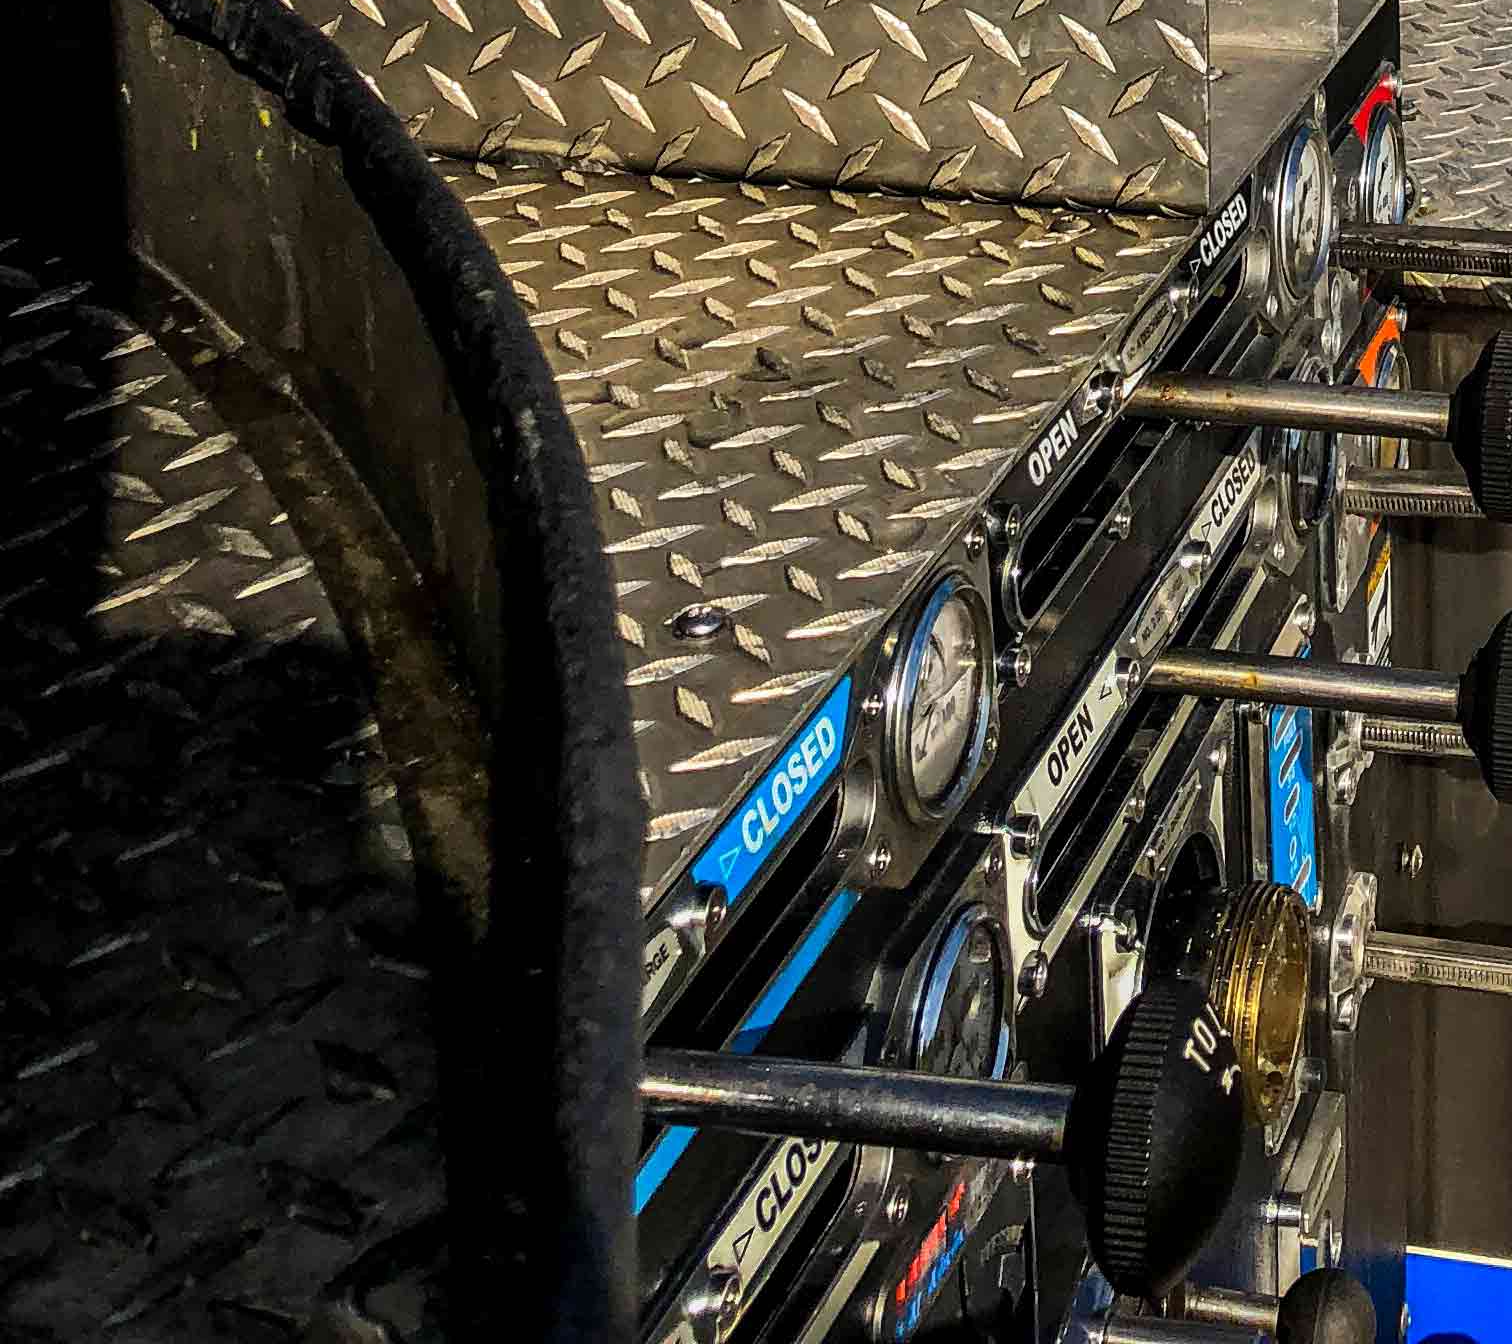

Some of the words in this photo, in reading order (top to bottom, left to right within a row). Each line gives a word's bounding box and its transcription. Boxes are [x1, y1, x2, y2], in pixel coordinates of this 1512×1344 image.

[1200, 193, 1248, 267] CLOSED
[1028, 409, 1079, 487] OPEN
[1211, 446, 1255, 527] CLOSED
[742, 716, 836, 854] CLOSED
[1047, 703, 1094, 787] OPEN
